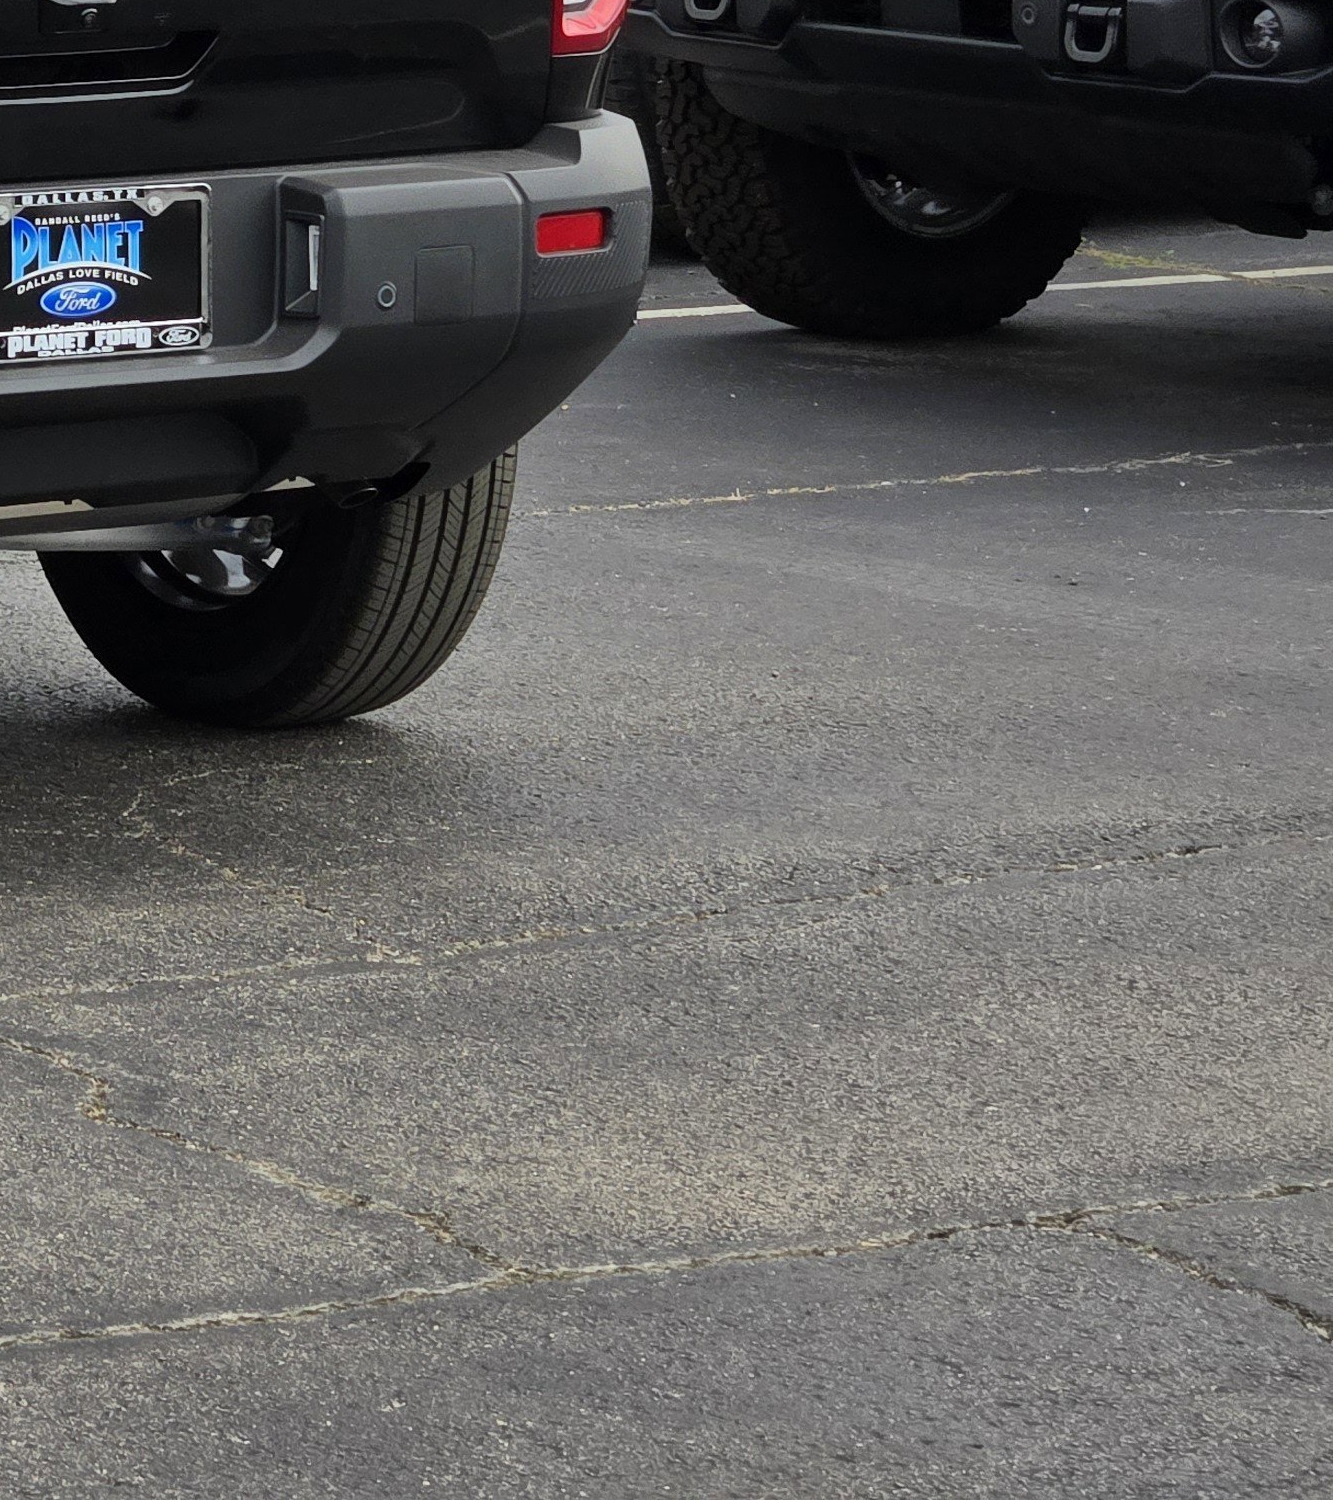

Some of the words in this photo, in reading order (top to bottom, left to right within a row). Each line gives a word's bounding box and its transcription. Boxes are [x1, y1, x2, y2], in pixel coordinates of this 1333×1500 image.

[35, 214, 81, 226] RANDALL
[11, 216, 144, 283] PLANET
[17, 272, 63, 295] DALLAS
[68, 268, 101, 280] LOVE
[104, 270, 139, 286] FIELD
[56, 288, 101, 312] Ford
[7, 332, 90, 359] PLANET
[94, 327, 152, 349] FORD
